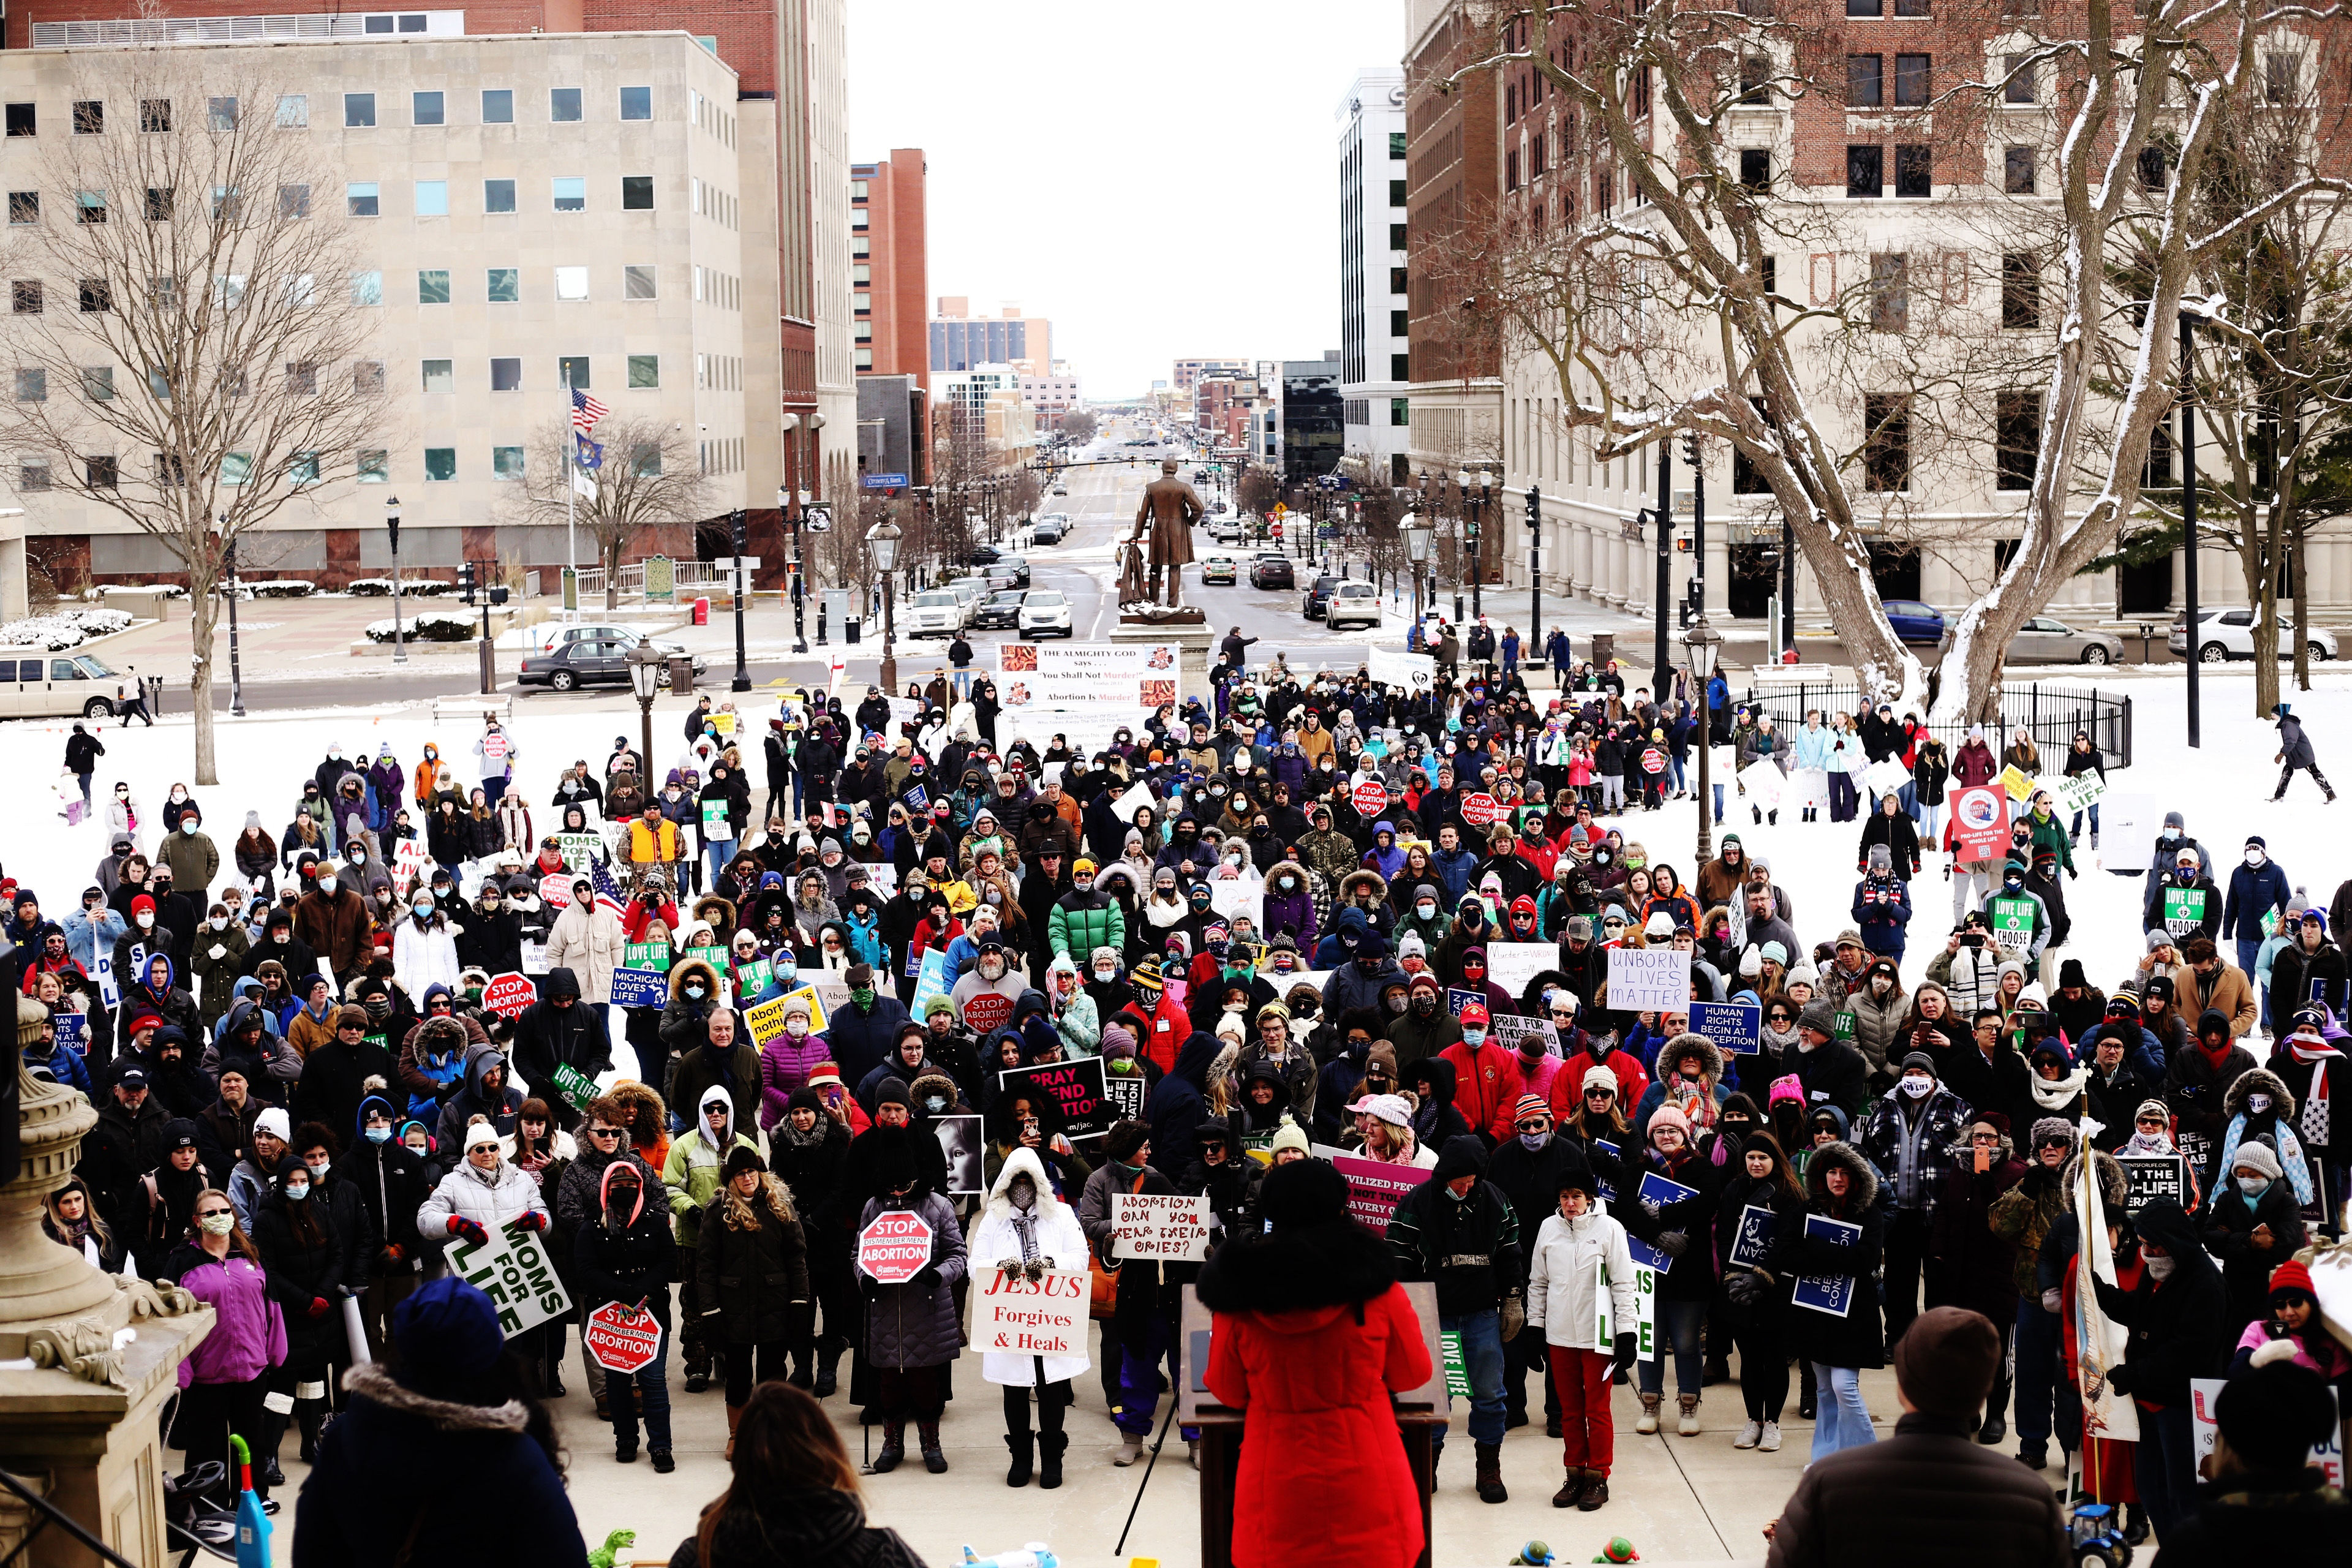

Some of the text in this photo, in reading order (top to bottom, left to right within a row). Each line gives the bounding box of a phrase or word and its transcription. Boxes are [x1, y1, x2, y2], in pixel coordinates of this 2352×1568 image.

[1249, 702, 1257, 710] LIFE
[2003, 774, 2021, 789] nothing
[2058, 771, 2097, 792] MOMS
[2072, 782, 2092, 795] FOR
[907, 788, 920, 798] HUMAN
[1361, 786, 1382, 795] STOP
[1354, 794, 1385, 804] ABORTION
[1471, 798, 1491, 807] STOP
[2068, 786, 2105, 810] LIFE
[703, 801, 727, 812] LOVE LIFE
[1358, 803, 1381, 812] NOW
[1463, 805, 1495, 815] ABORTION
[1466, 813, 1490, 822] NOW
[706, 822, 727, 831] CHOOSE
[1960, 831, 1980, 840] PRO-LIFE
[400, 842, 425, 856] ALL
[467, 859, 497, 873] PRAY TO
[545, 894, 570, 905] NOW
[2166, 890, 2204, 906] LOVE LIFE
[1996, 902, 2033, 917] LOVE LIFE
[1998, 930, 2027, 944] CHOOSE
[627, 943, 668, 960] LOVE LIFE
[710, 948, 728, 963] LIFE
[1488, 945, 1557, 959] Murder WRONG
[1613, 951, 1679, 968] UNBORN
[738, 960, 771, 982] OVE LIFE
[1488, 962, 1519, 976] Abortion
[615, 971, 667, 986] MICHIGAN
[921, 978, 943, 992] stops
[1625, 969, 1681, 987] LIVES
[492, 980, 524, 996] STOP
[614, 981, 646, 993] LOVES
[487, 991, 534, 1009] ABORTION
[612, 990, 638, 1001] LIFE!
[802, 991, 813, 1001] is
[1611, 988, 1681, 1006] MATTER
[972, 998, 1005, 1009] STOP
[496, 1004, 529, 1019] NOW
[965, 1006, 1014, 1019] ABORTION
[1705, 1006, 1744, 1017] HUMAN
[974, 1019, 1010, 1029] NOW
[1495, 1016, 1544, 1030] PRAY FOR
[1706, 1017, 1742, 1027] RIGHTS
[1835, 1014, 1852, 1032] IFE
[1496, 1027, 1529, 1039] THOSE
[1701, 1025, 1747, 1036] BEGIN AT
[554, 1065, 600, 1099] LOVE LIFE
[1030, 1068, 1077, 1088] PRAY
[1341, 1174, 1391, 1189] IVILIZED
[2145, 1170, 2174, 1179] THE
[1356, 1189, 1376, 1199] NOT
[1122, 1196, 1196, 1209] ABORTION
[1349, 1200, 1386, 1213] AVERY
[1121, 1210, 1150, 1223] CAN
[875, 1220, 918, 1235] STOP
[1113, 1226, 1207, 1239] HEAR THEIR
[864, 1237, 927, 1246] DISMEMBERMENT
[1134, 1240, 1190, 1256] CRIES?
[862, 1246, 927, 1262] ABORTION
[1451, 1254, 1490, 1266] MICHIGAN STATE
[500, 1218, 564, 1315] MOMS
[493, 1256, 530, 1303] FOR
[985, 1269, 1083, 1298] JESUS
[451, 1245, 524, 1333] LIFE
[605, 1308, 649, 1328] STOP
[994, 1306, 1072, 1328] Forgives
[592, 1321, 656, 1341] DISMEMBERMENT
[589, 1330, 655, 1356] ABORTION
[994, 1332, 1068, 1352] & Heals
[1441, 1334, 1470, 1394] LOVE LIFE
